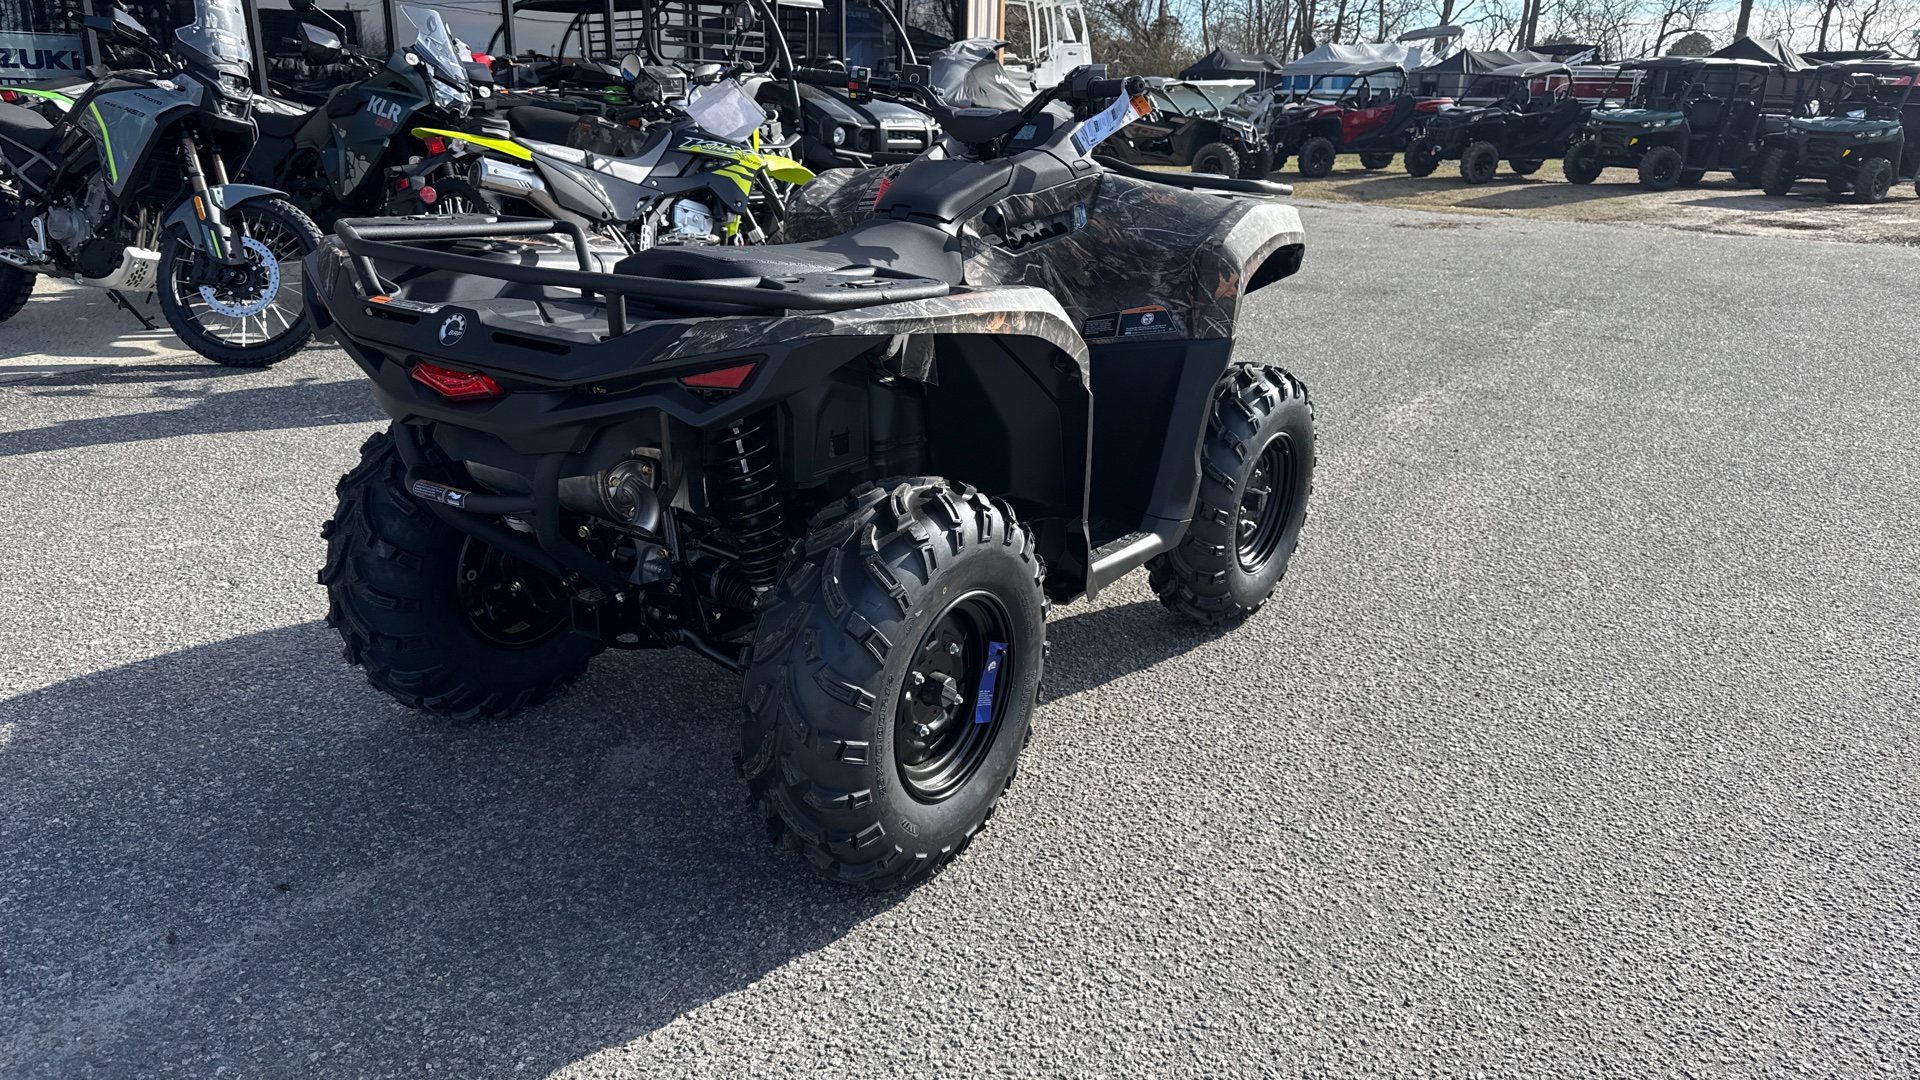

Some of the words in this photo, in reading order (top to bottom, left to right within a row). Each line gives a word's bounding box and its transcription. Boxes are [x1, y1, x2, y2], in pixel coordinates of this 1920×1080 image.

[133, 91, 163, 106] CFMOTO
[366, 94, 402, 123] KLR
[448, 329, 463, 337] BRP
